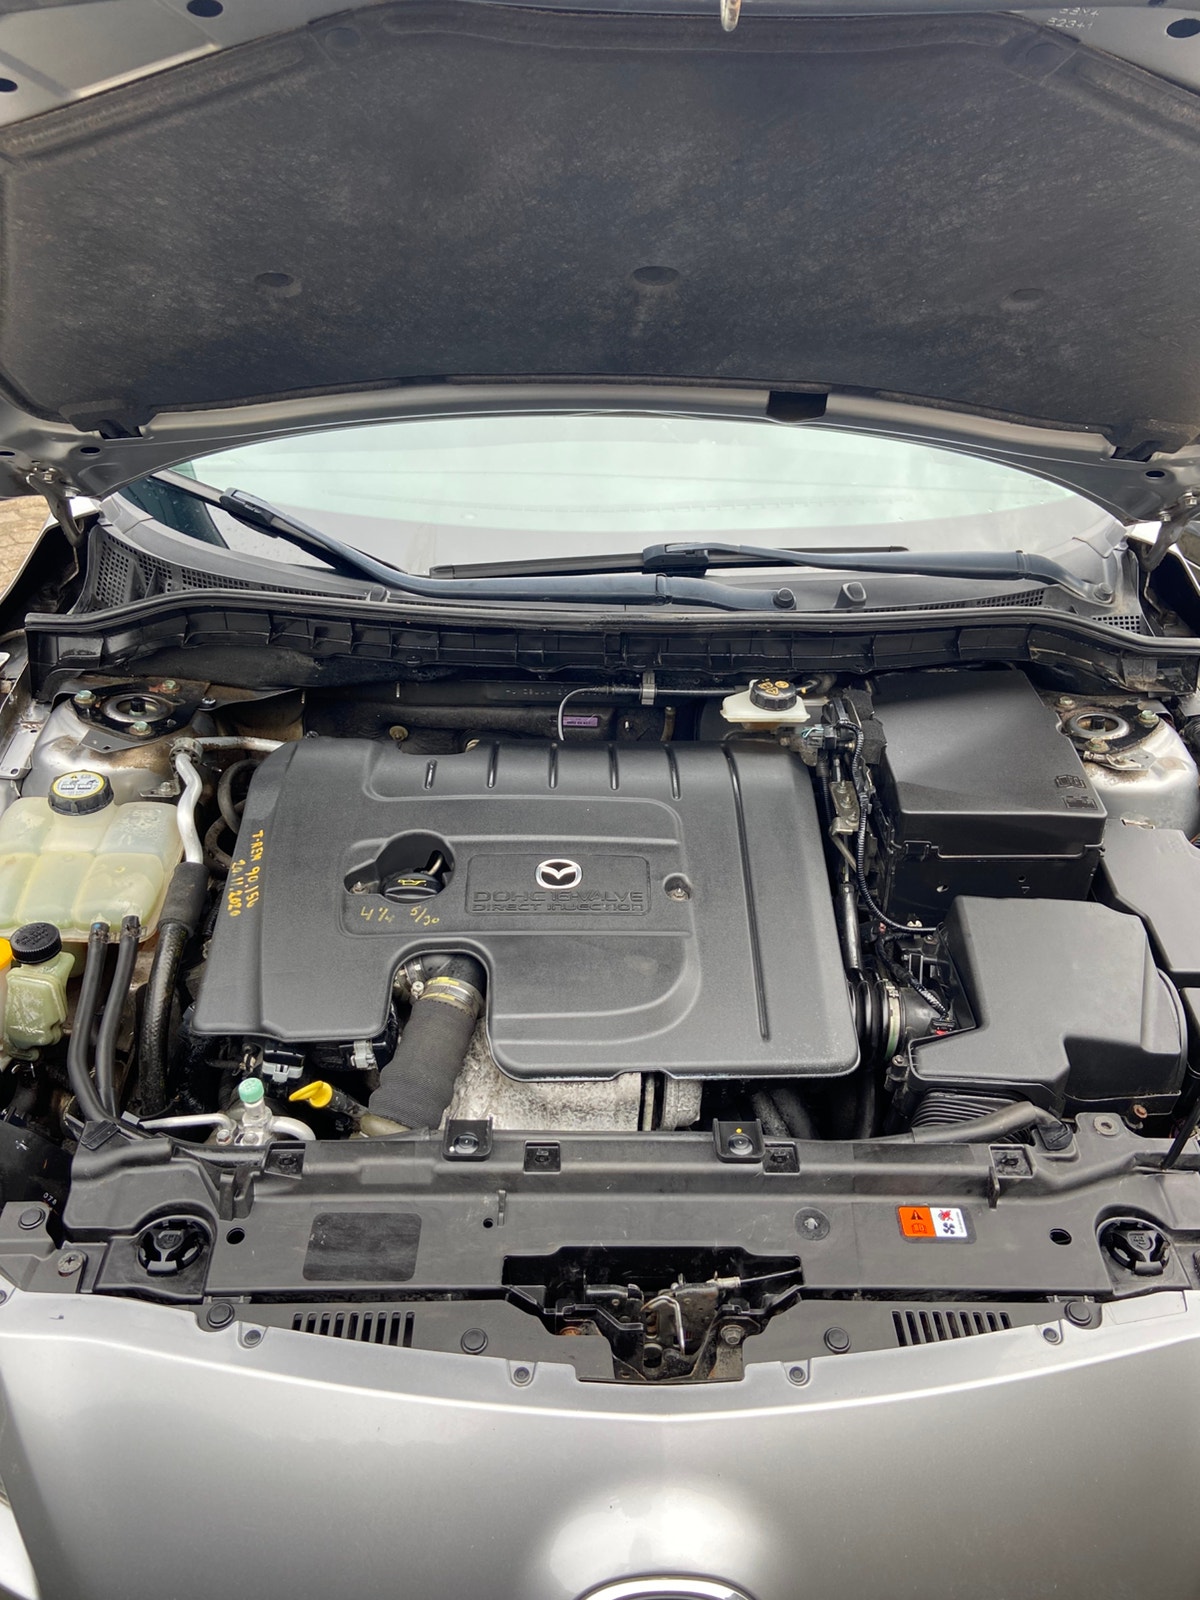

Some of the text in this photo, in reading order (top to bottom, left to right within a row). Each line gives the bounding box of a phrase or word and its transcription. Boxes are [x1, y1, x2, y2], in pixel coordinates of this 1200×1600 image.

[473, 890, 644, 902] DOHC 16-VALVE
[472, 903, 543, 912] DIRECT
